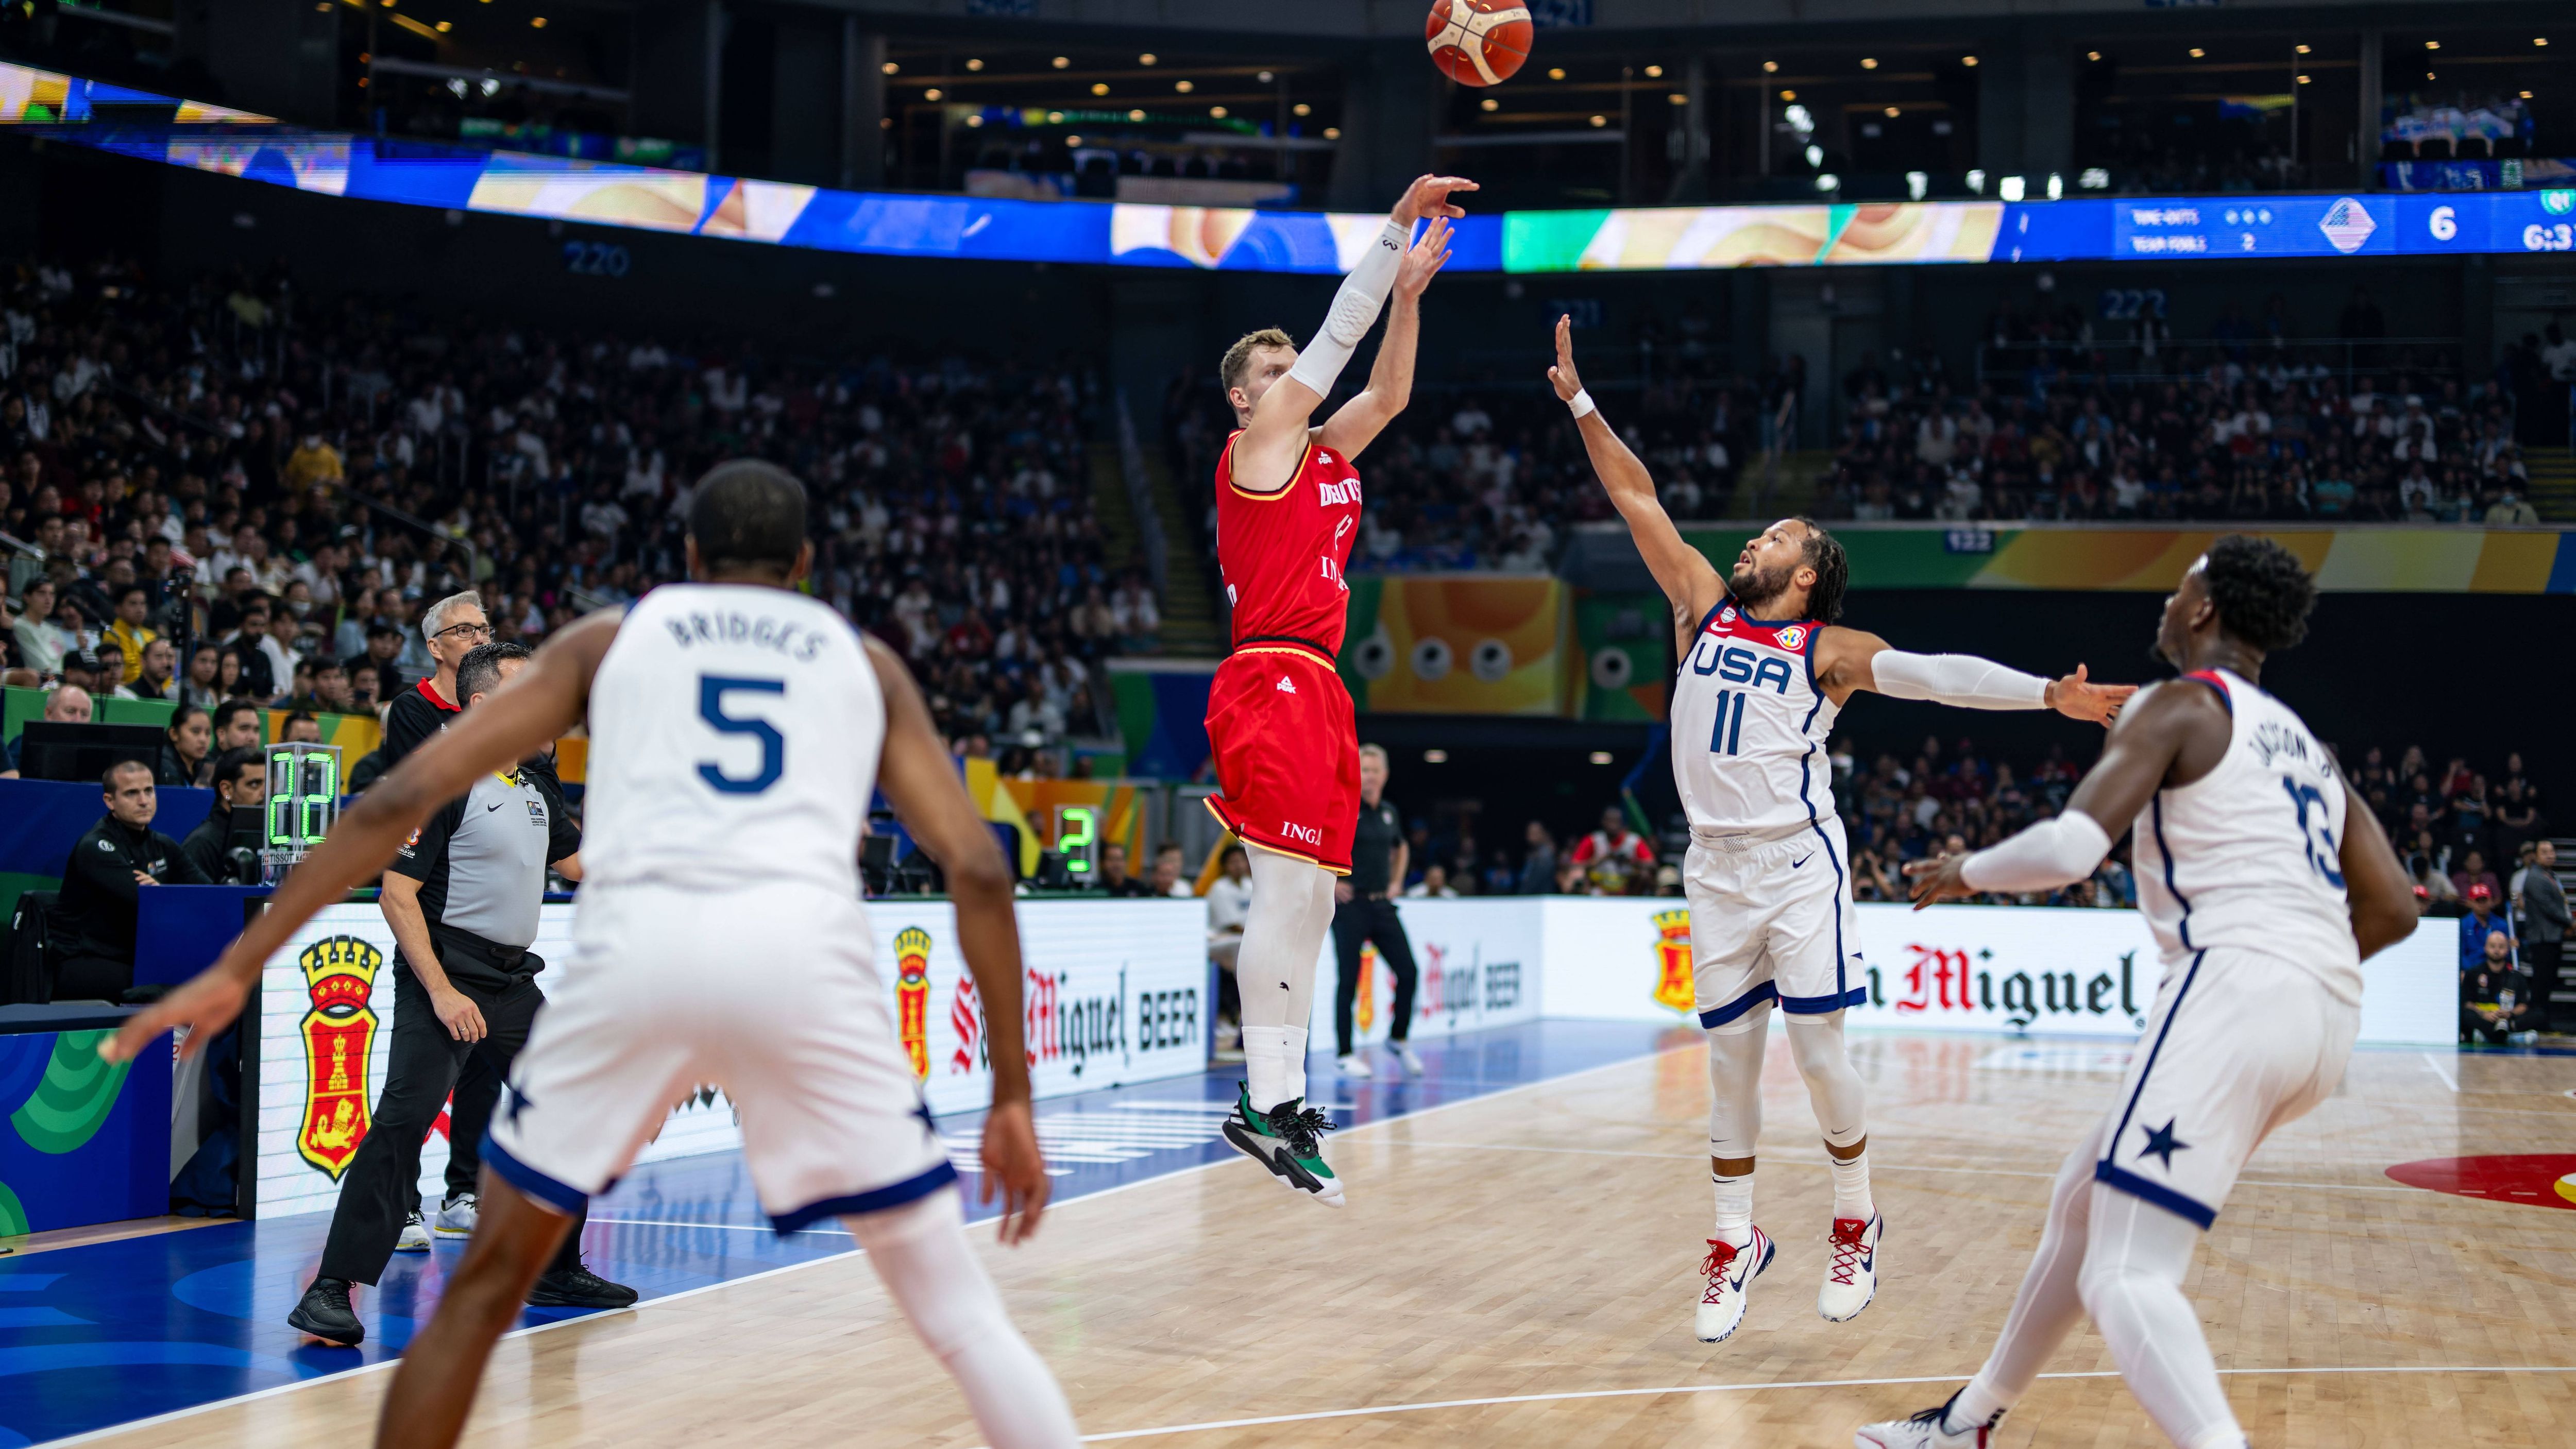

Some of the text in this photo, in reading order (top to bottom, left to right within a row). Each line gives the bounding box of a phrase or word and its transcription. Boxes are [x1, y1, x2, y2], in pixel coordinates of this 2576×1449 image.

[2429, 206, 2457, 241] 6
[2523, 224, 2576, 250] 6:3
[564, 241, 631, 278] 220
[1319, 478, 1362, 507] DEUTS
[1320, 556, 1341, 583] IN
[668, 611, 828, 662] BRIDGES
[1277, 683, 1297, 694] PEAK
[1693, 642, 1792, 695] USA
[697, 675, 784, 793] 5
[1710, 689, 1745, 756] 11
[1059, 808, 1094, 872] 2
[1280, 821, 1316, 844] ING
[2283, 775, 2348, 890] 13
[270, 854, 294, 864] TISSOT
[1896, 944, 2139, 1027] Miguel
[1025, 964, 1131, 1078] Miguel
[1139, 987, 1197, 1052] BEER
